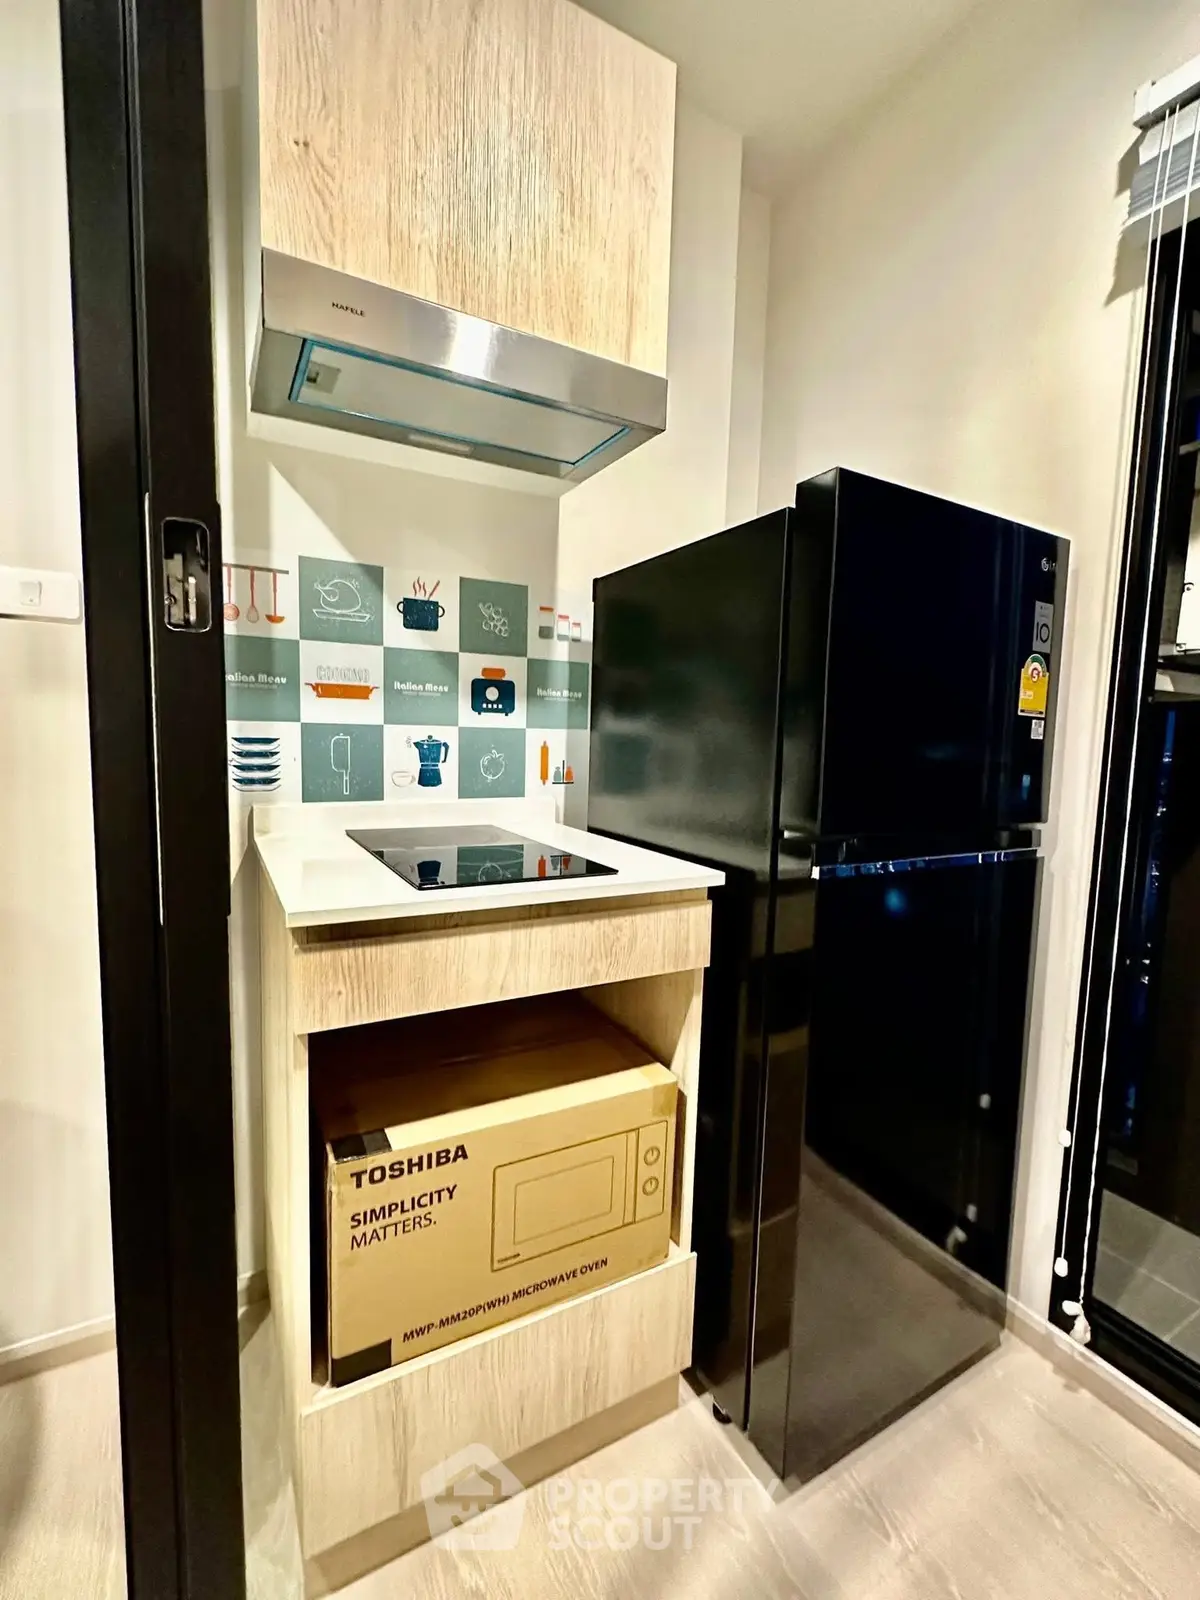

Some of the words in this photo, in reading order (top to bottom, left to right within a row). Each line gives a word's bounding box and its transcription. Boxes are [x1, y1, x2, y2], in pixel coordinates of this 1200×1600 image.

[1035, 621, 1050, 643] 10
[257, 673, 287, 685] Menu
[393, 680, 424, 691] Italian
[425, 683, 449, 693] Menu
[536, 687, 561, 697] Italian
[562, 689, 582, 698] Menu
[349, 1143, 469, 1189] TOSHIBA
[350, 1183, 458, 1230] SIMPLICITY
[350, 1211, 437, 1251] MATTERS.
[402, 1293, 510, 1343] MWP-MM20P(WH)
[511, 1267, 579, 1301] MICROWAVE
[579, 1256, 609, 1275] OVEN
